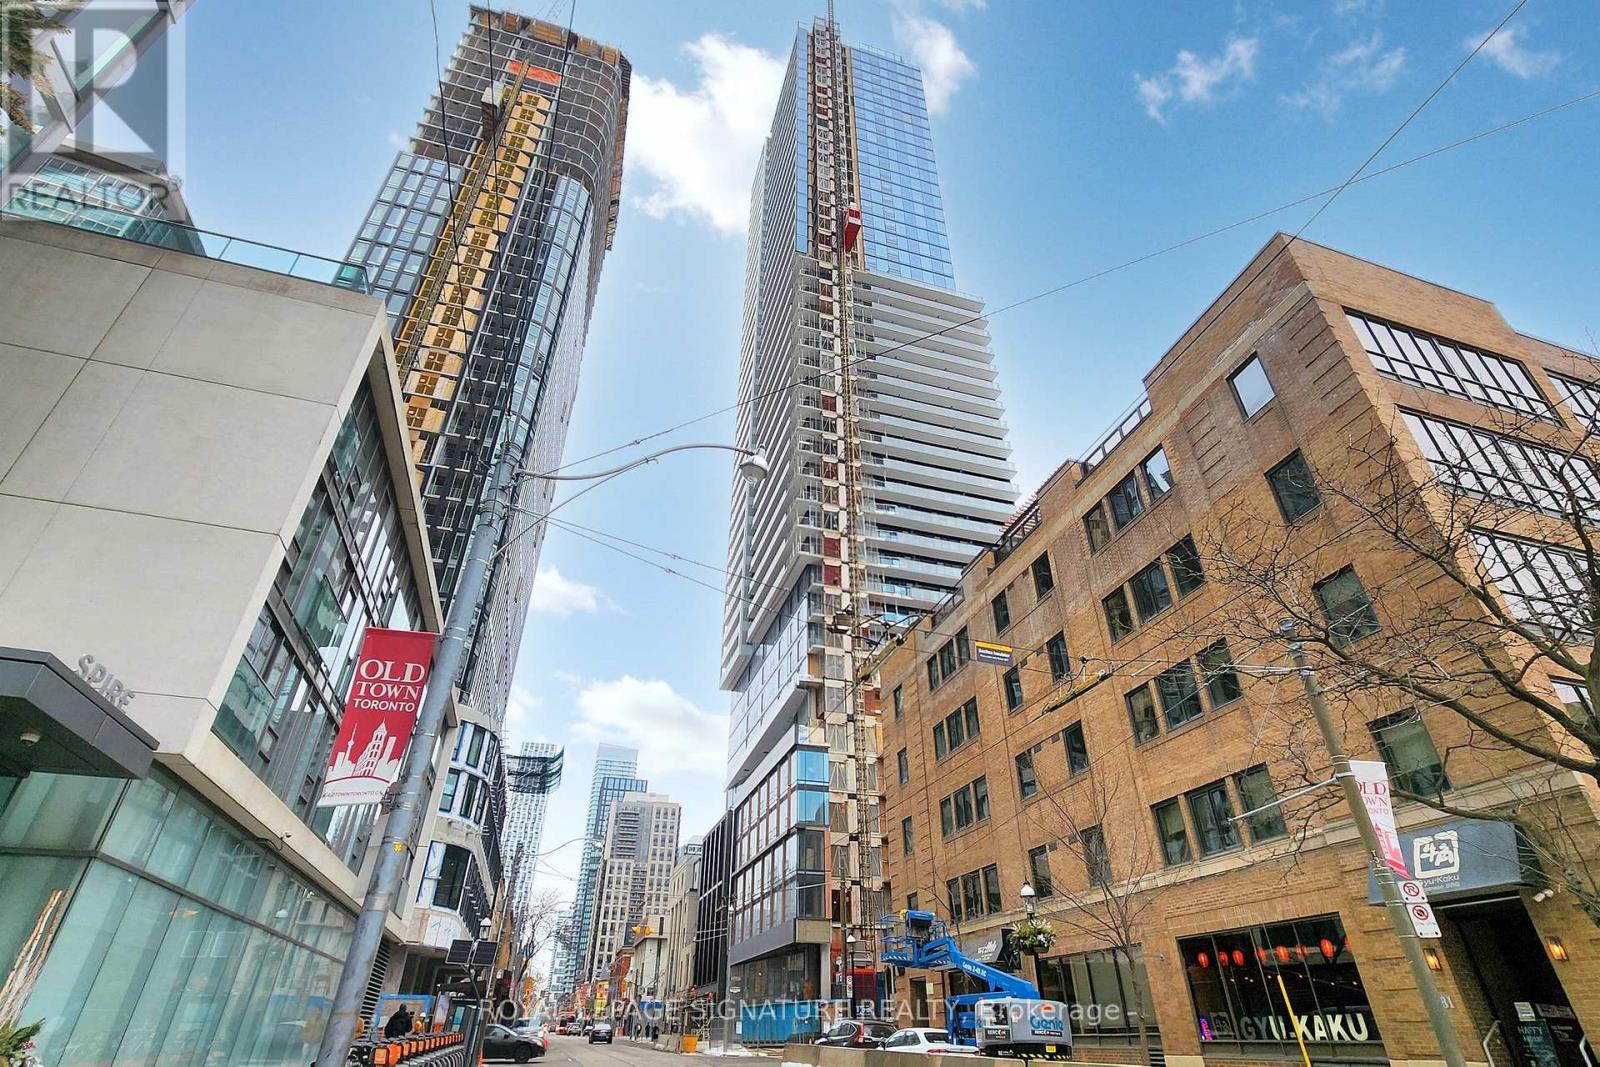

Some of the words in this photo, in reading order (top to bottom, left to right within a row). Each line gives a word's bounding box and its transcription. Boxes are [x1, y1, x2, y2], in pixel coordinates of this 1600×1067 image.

[360, 659, 426, 683] OLD
[79, 654, 135, 714] SPIRE
[356, 680, 422, 700] TOWN
[353, 698, 416, 713] TORONTO
[1365, 796, 1388, 807] WN
[1369, 807, 1390, 816] ONTO
[1440, 995, 1455, 1009] 81
[1030, 1015, 1064, 1031] Genie
[1240, 1013, 1369, 1042] GYU-KAKU
